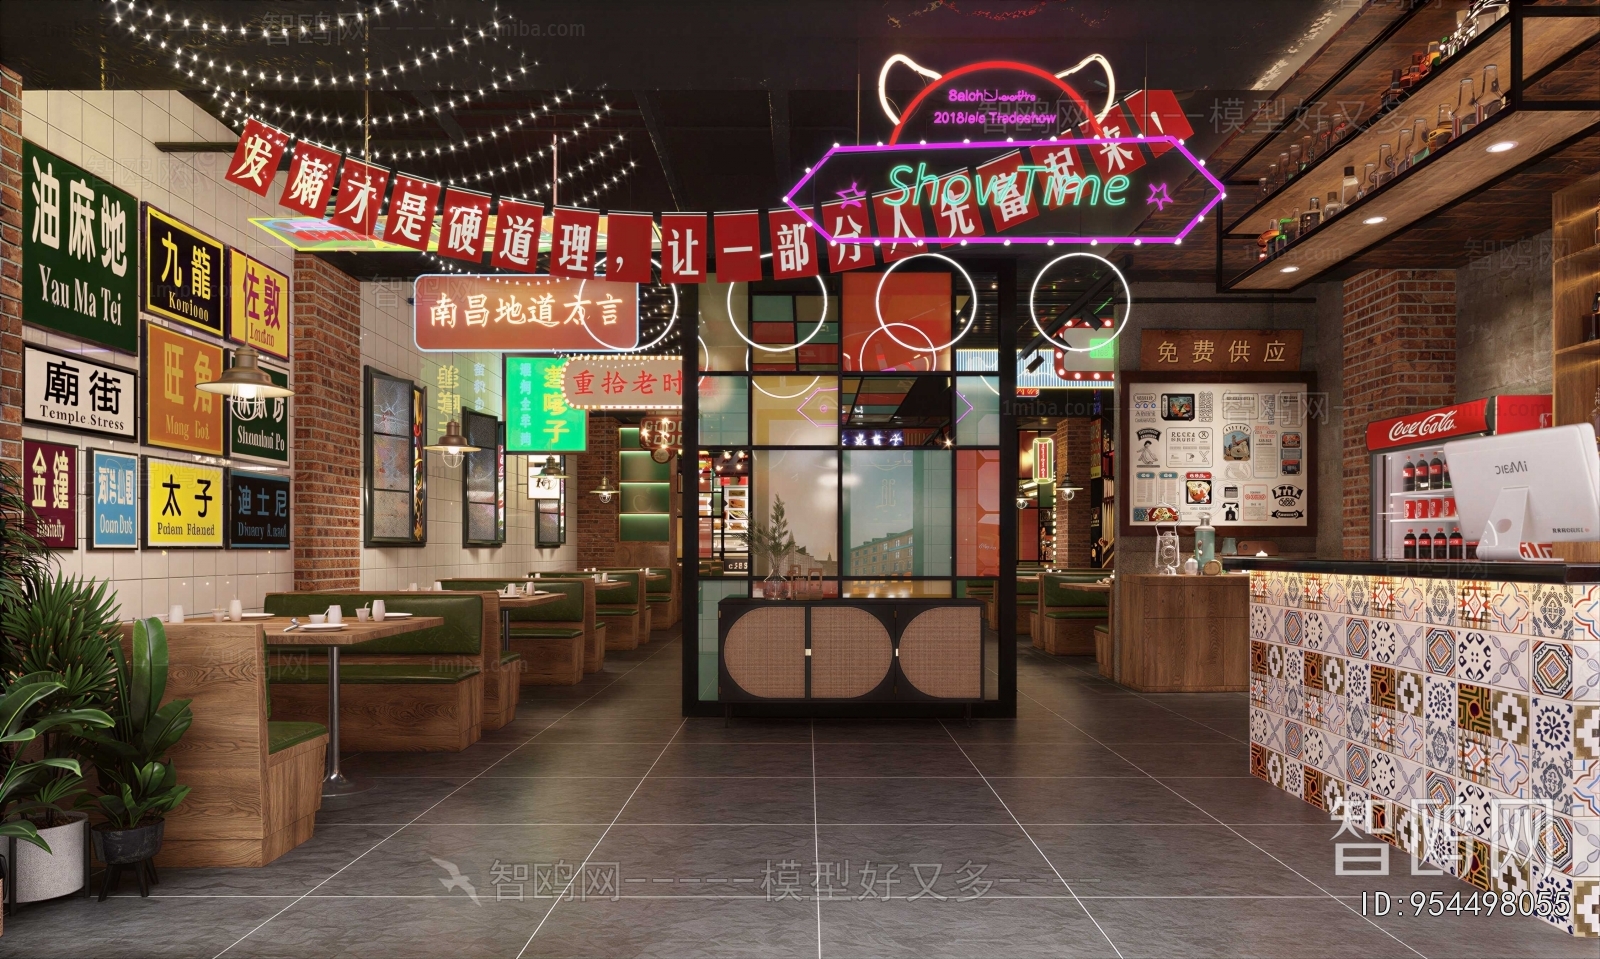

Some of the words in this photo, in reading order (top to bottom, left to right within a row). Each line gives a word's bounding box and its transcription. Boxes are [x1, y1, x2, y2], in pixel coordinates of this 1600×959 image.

[161, 231, 211, 300] 九龍
[38, 264, 70, 308] Yau
[74, 278, 97, 318] Ma
[101, 289, 122, 326] Tei
[242, 266, 281, 331] 佐敦
[164, 342, 213, 415] 旺角
[1157, 339, 1286, 364] 免费供应
[40, 404, 86, 425] Temple
[44, 361, 122, 415] 廟街
[161, 473, 213, 518] 太子
[238, 485, 287, 517] 迪士尼
